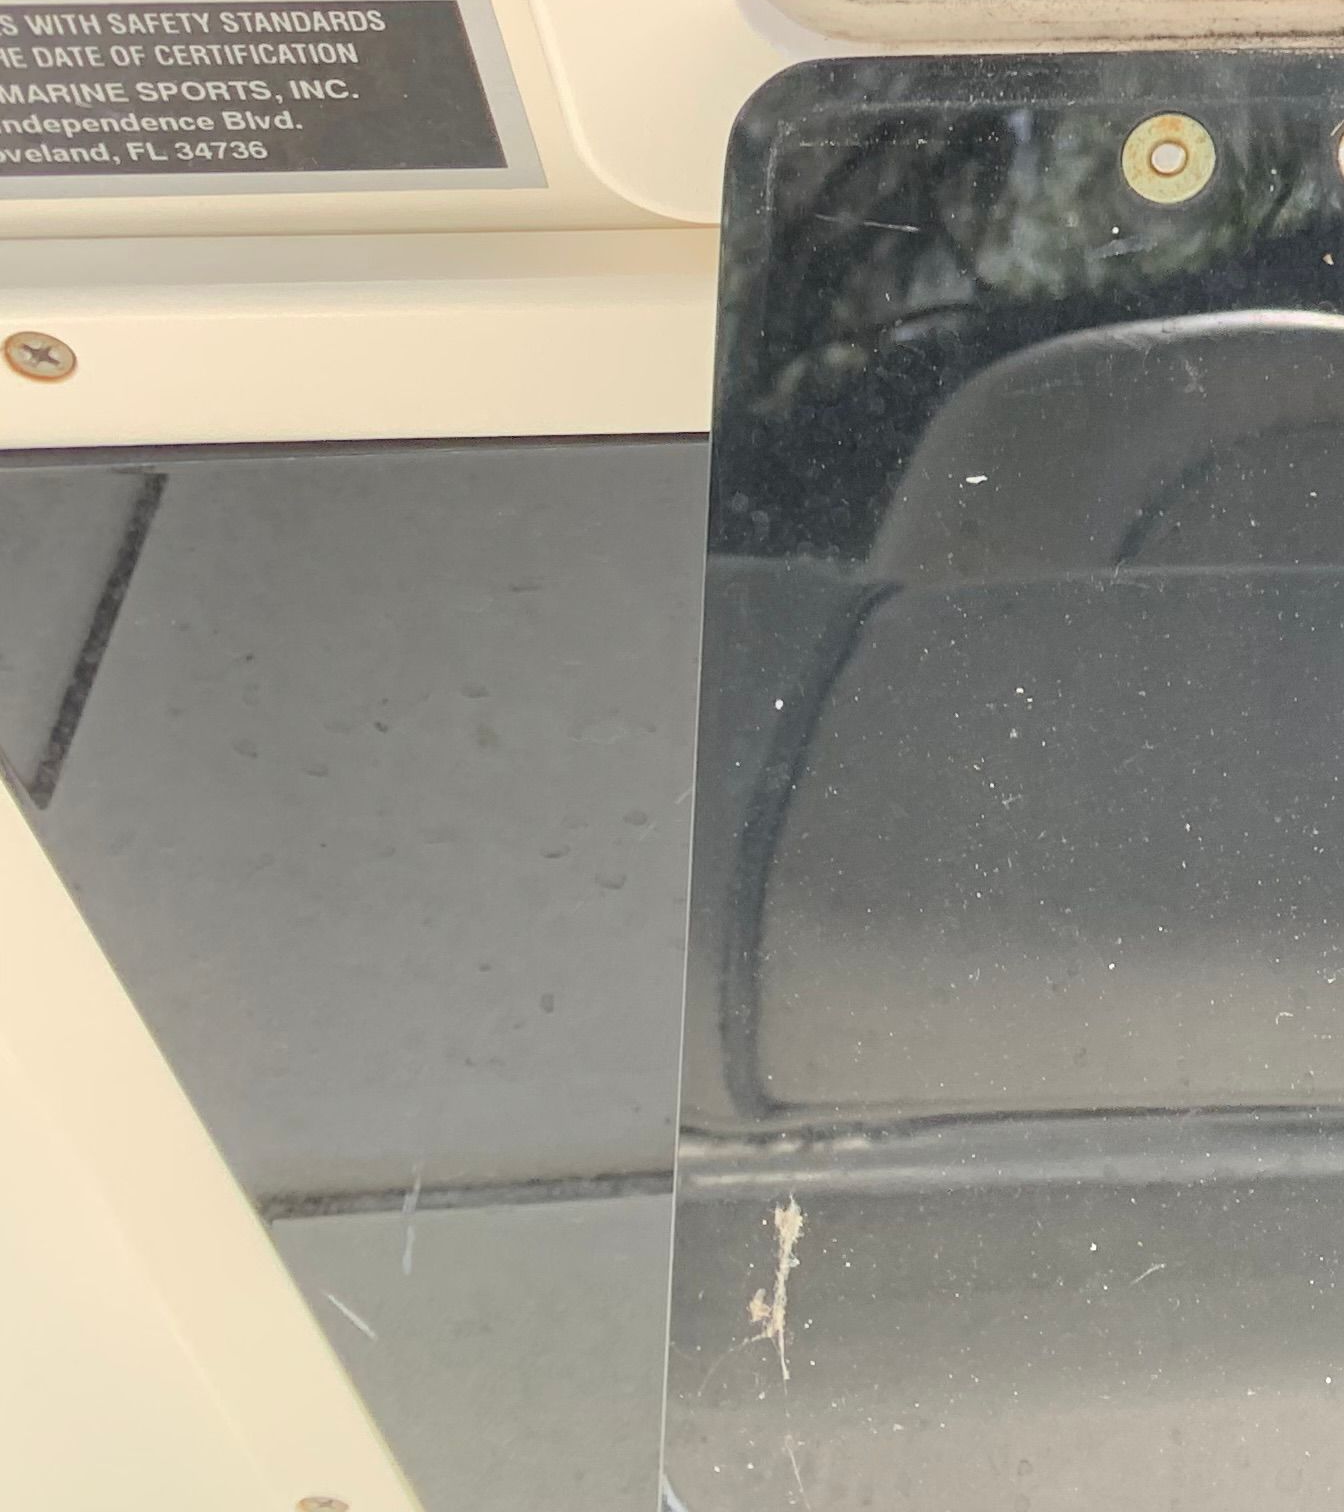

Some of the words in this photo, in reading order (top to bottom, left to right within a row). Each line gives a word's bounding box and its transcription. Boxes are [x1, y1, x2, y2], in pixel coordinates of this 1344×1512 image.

[24, 14, 102, 36] WITH
[110, 12, 210, 35] SAFETY
[220, 10, 386, 33] STANDARDS
[32, 46, 105, 68] DATE
[111, 45, 146, 67] OF
[154, 43, 359, 66] CERTIFICATION
[0, 83, 129, 105] MARINE
[138, 80, 283, 104] SPORTS,
[289, 79, 359, 101] INC.
[0, 112, 214, 138] ndependence
[222, 110, 303, 131] Blvd.
[127, 142, 168, 162] FL
[174, 141, 268, 161] 34736
